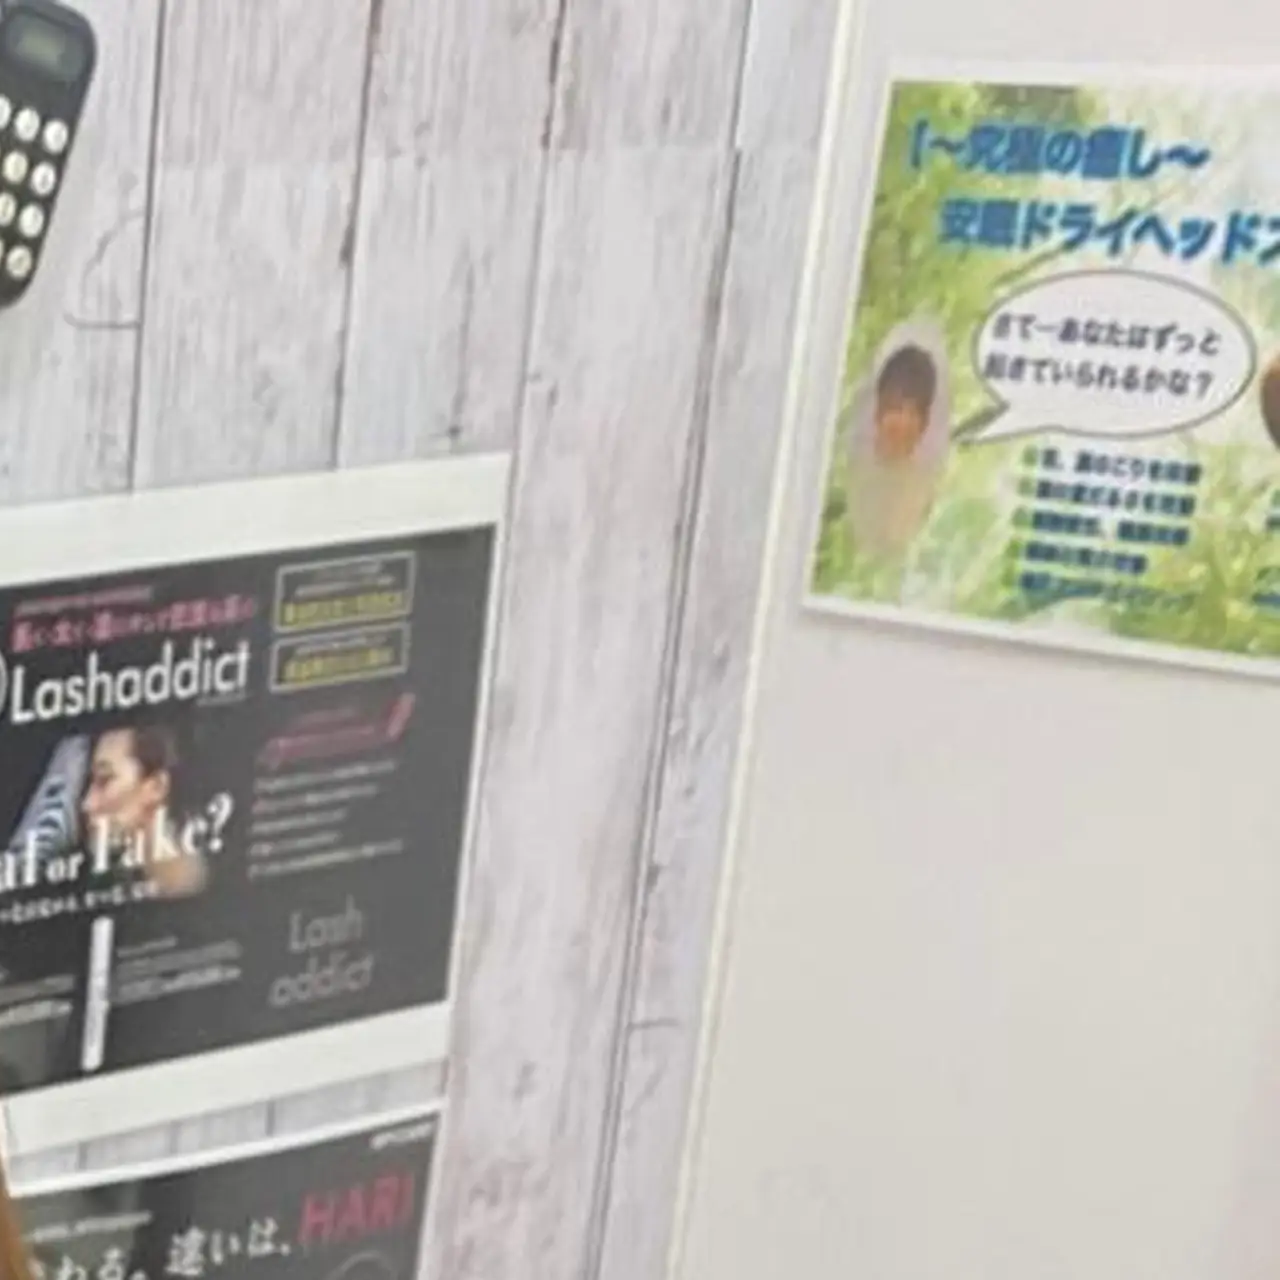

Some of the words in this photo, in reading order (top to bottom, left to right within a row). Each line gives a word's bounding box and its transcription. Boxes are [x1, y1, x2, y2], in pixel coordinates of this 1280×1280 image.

[10, 635, 253, 725] Lashaddict
[45, 852, 85, 884] or
[90, 792, 234, 875] Fake?
